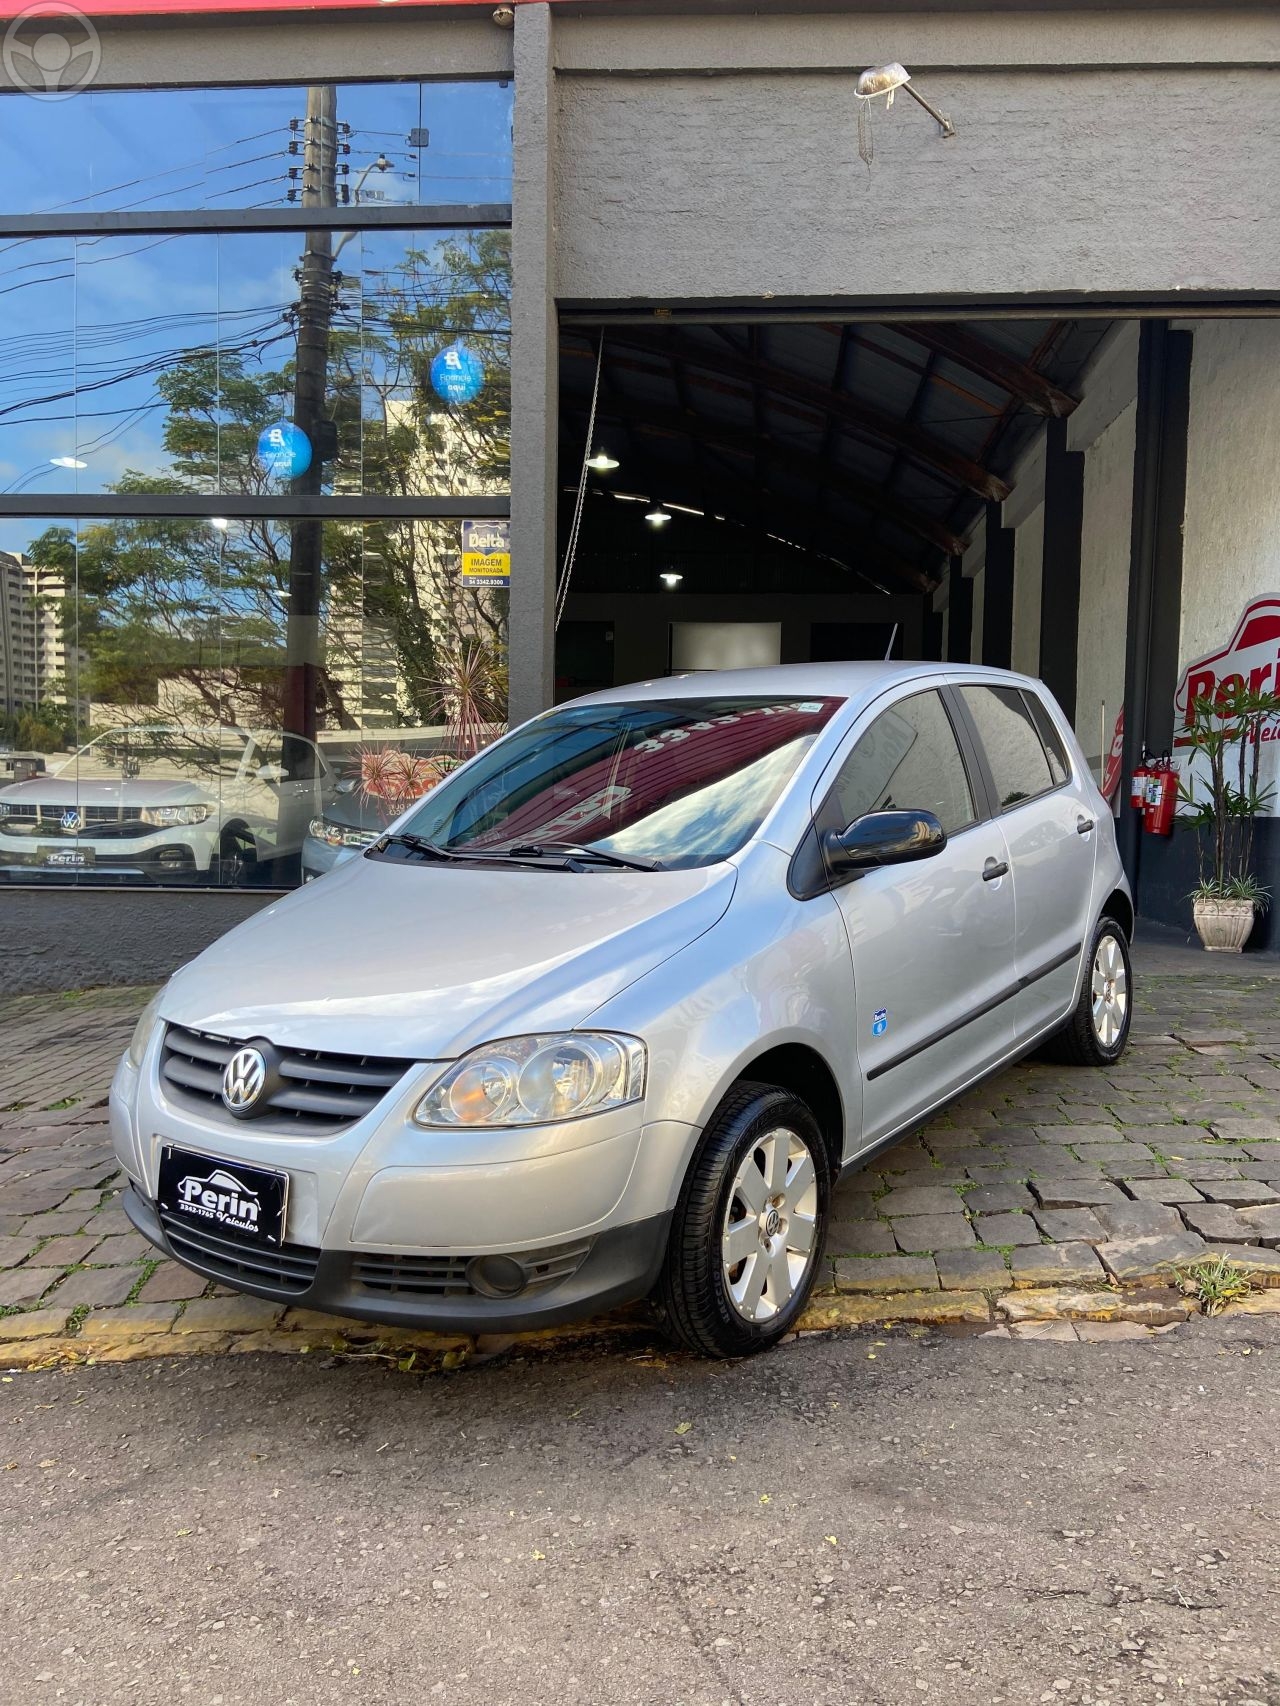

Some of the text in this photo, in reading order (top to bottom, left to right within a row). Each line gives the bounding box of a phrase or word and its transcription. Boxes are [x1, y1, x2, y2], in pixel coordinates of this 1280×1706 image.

[447, 383, 466, 392] aqui
[468, 533, 505, 548] Delta
[470, 558, 502, 566] IMAGEM
[49, 854, 85, 862] Perin
[183, 1179, 259, 1221] Perin
[179, 1203, 214, 1219] 3342-1765
